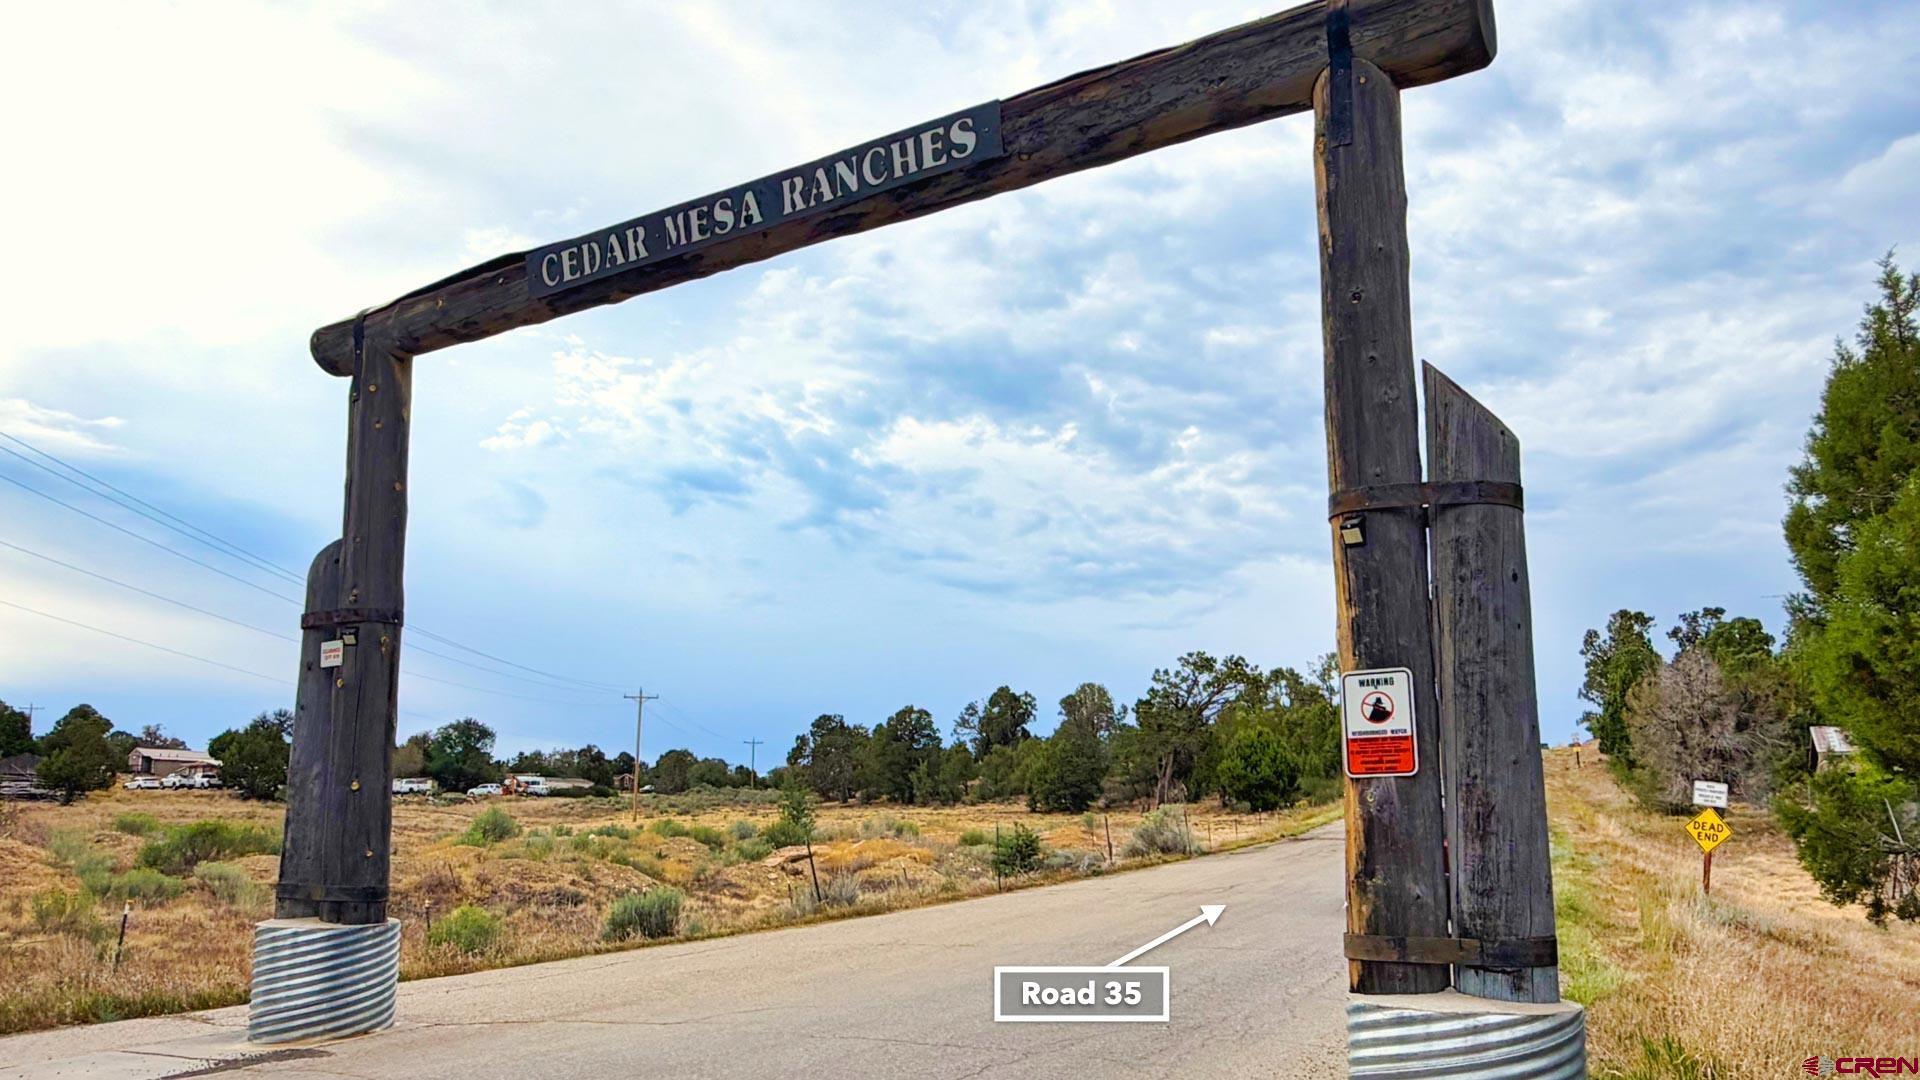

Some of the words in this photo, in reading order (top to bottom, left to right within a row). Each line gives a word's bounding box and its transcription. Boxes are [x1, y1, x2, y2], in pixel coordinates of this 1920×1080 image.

[541, 225, 648, 287] CEDAR
[664, 190, 763, 250] MESA
[781, 117, 977, 216] RANCHES
[1358, 677, 1395, 689] WARNING
[1693, 821, 1724, 833] DEAD
[1697, 832, 1719, 842] END
